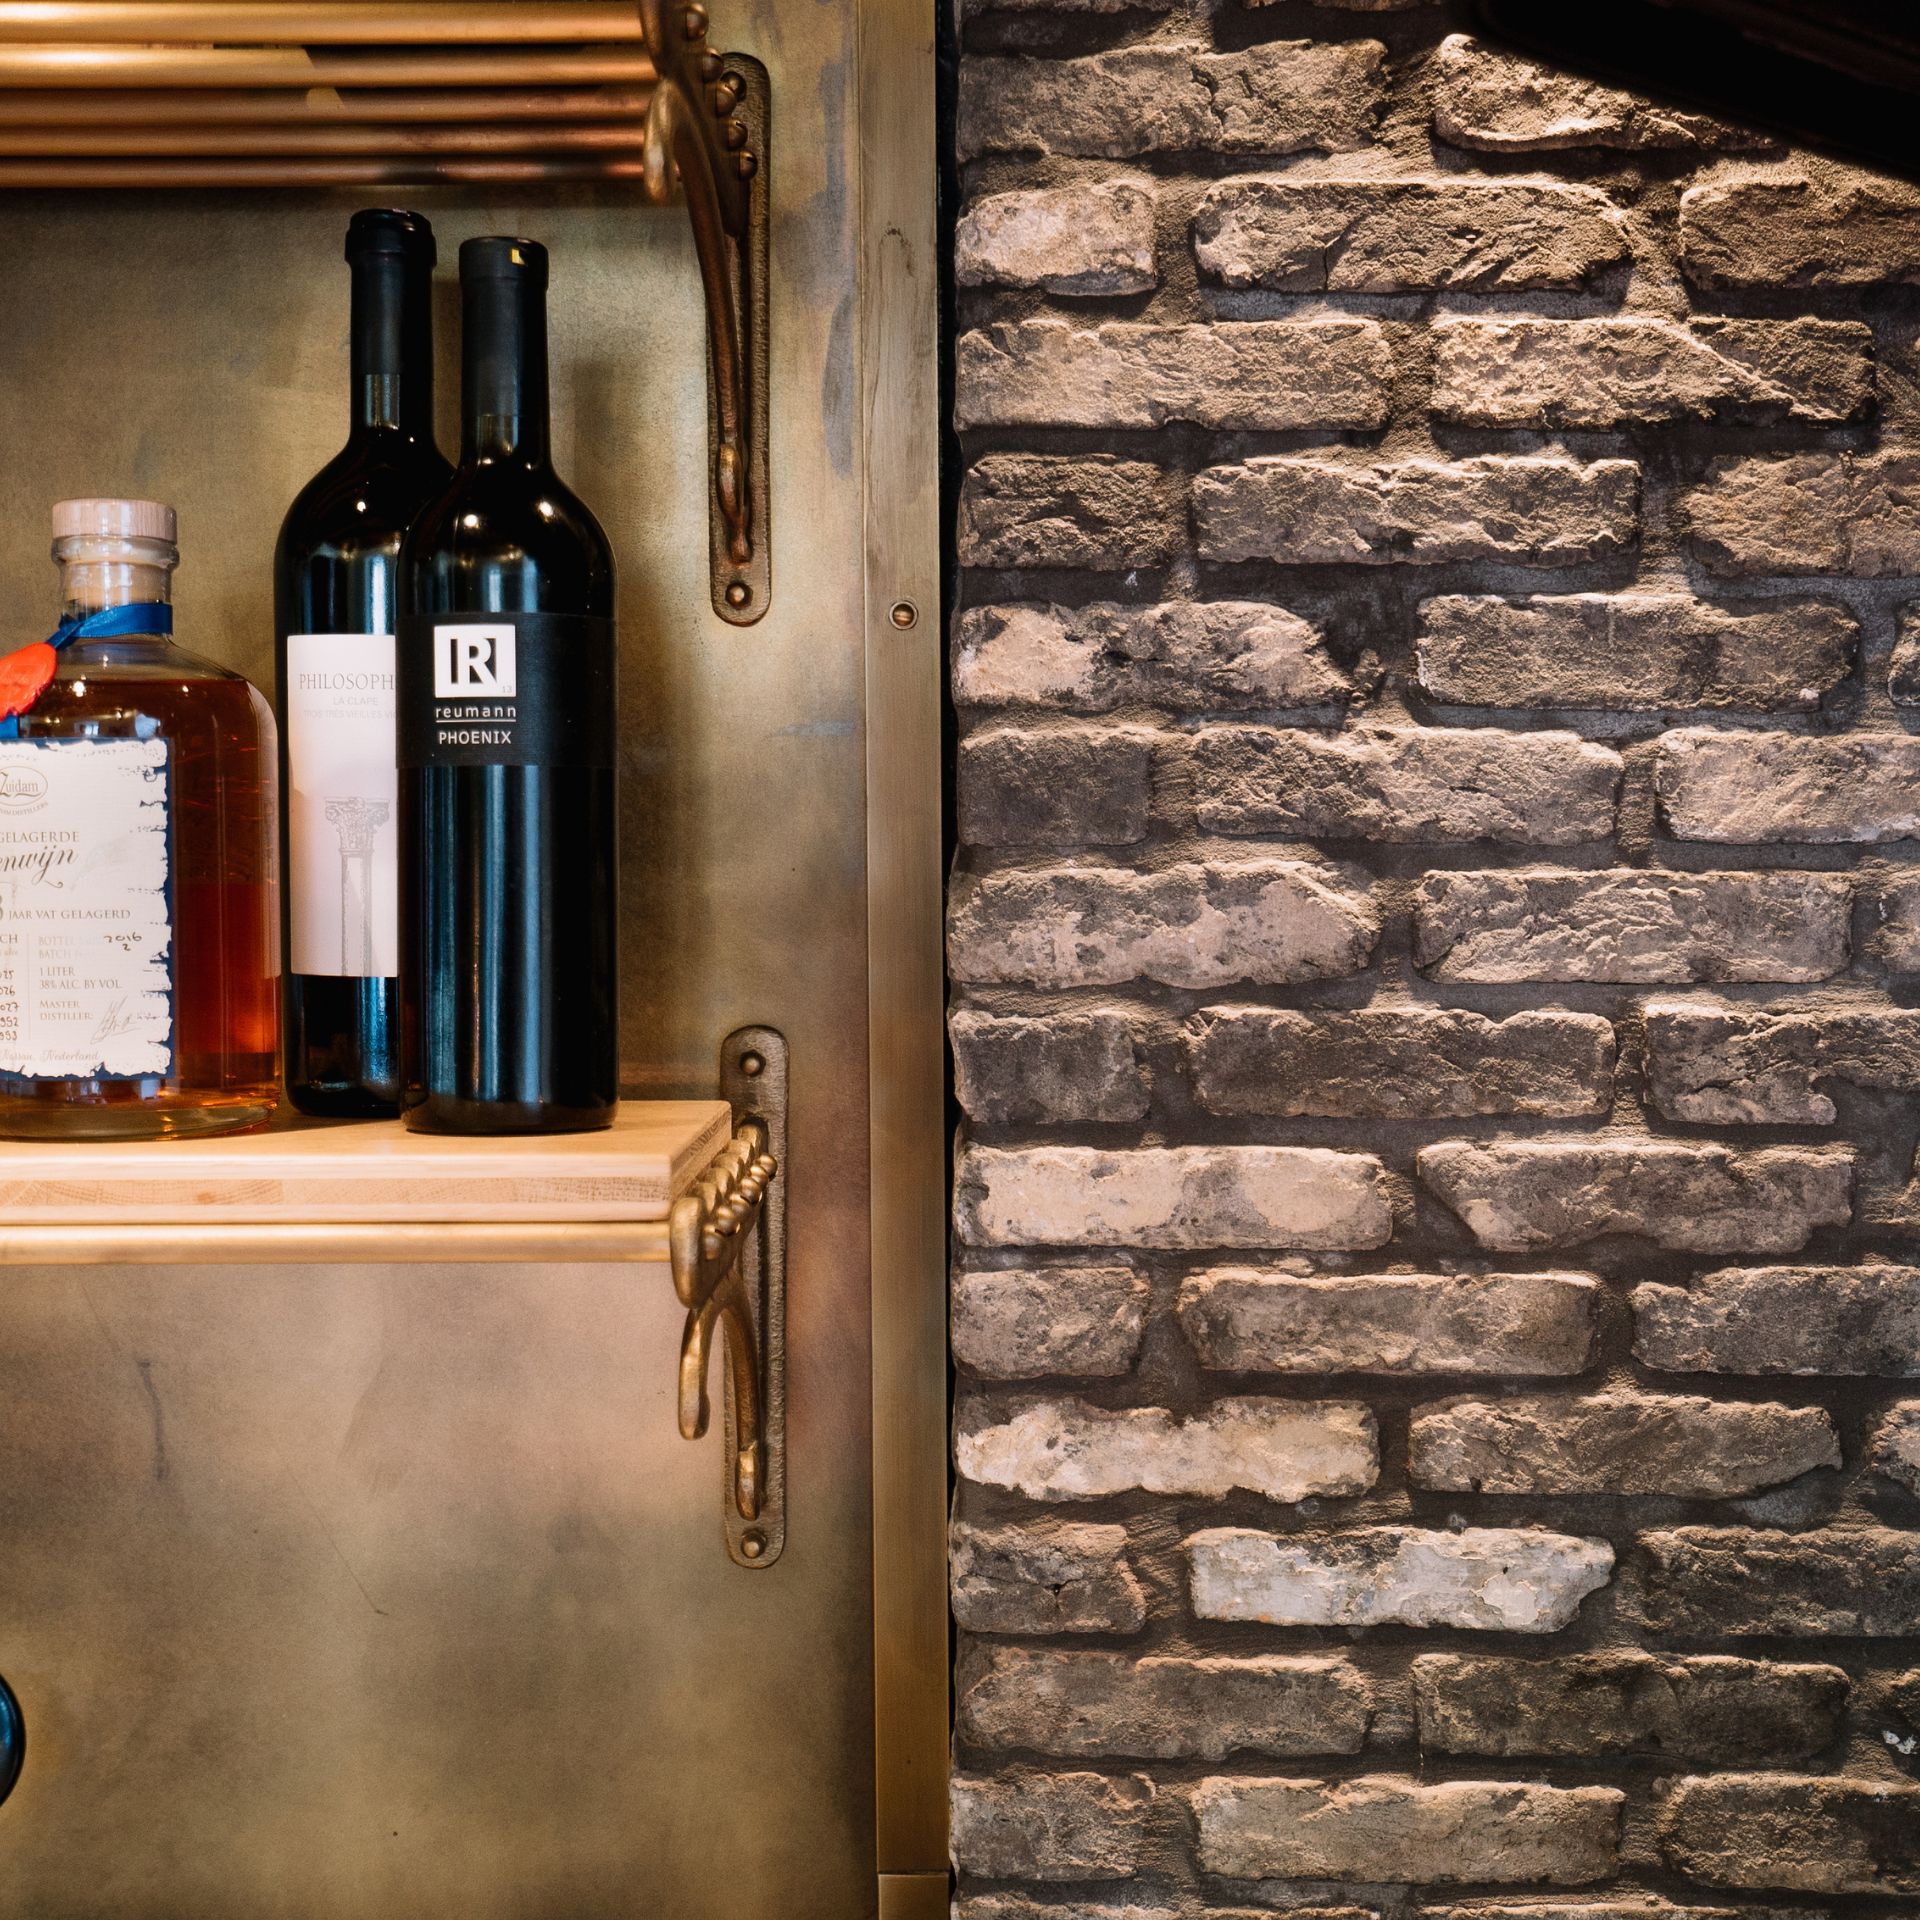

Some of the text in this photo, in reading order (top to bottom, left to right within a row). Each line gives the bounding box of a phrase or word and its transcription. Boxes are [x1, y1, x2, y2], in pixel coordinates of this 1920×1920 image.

[333, 697, 379, 706] LA CLAPE
[435, 706, 517, 719] reumann
[439, 730, 512, 745] PHOENIX
[9, 909, 131, 920] JAAR VAT GELAGERD
[103, 931, 143, 943] 2016
[122, 943, 132, 952] 2
[47, 966, 76, 976] LITER
[84, 979, 96, 989] BY
[39, 1000, 80, 1009] MASTER
